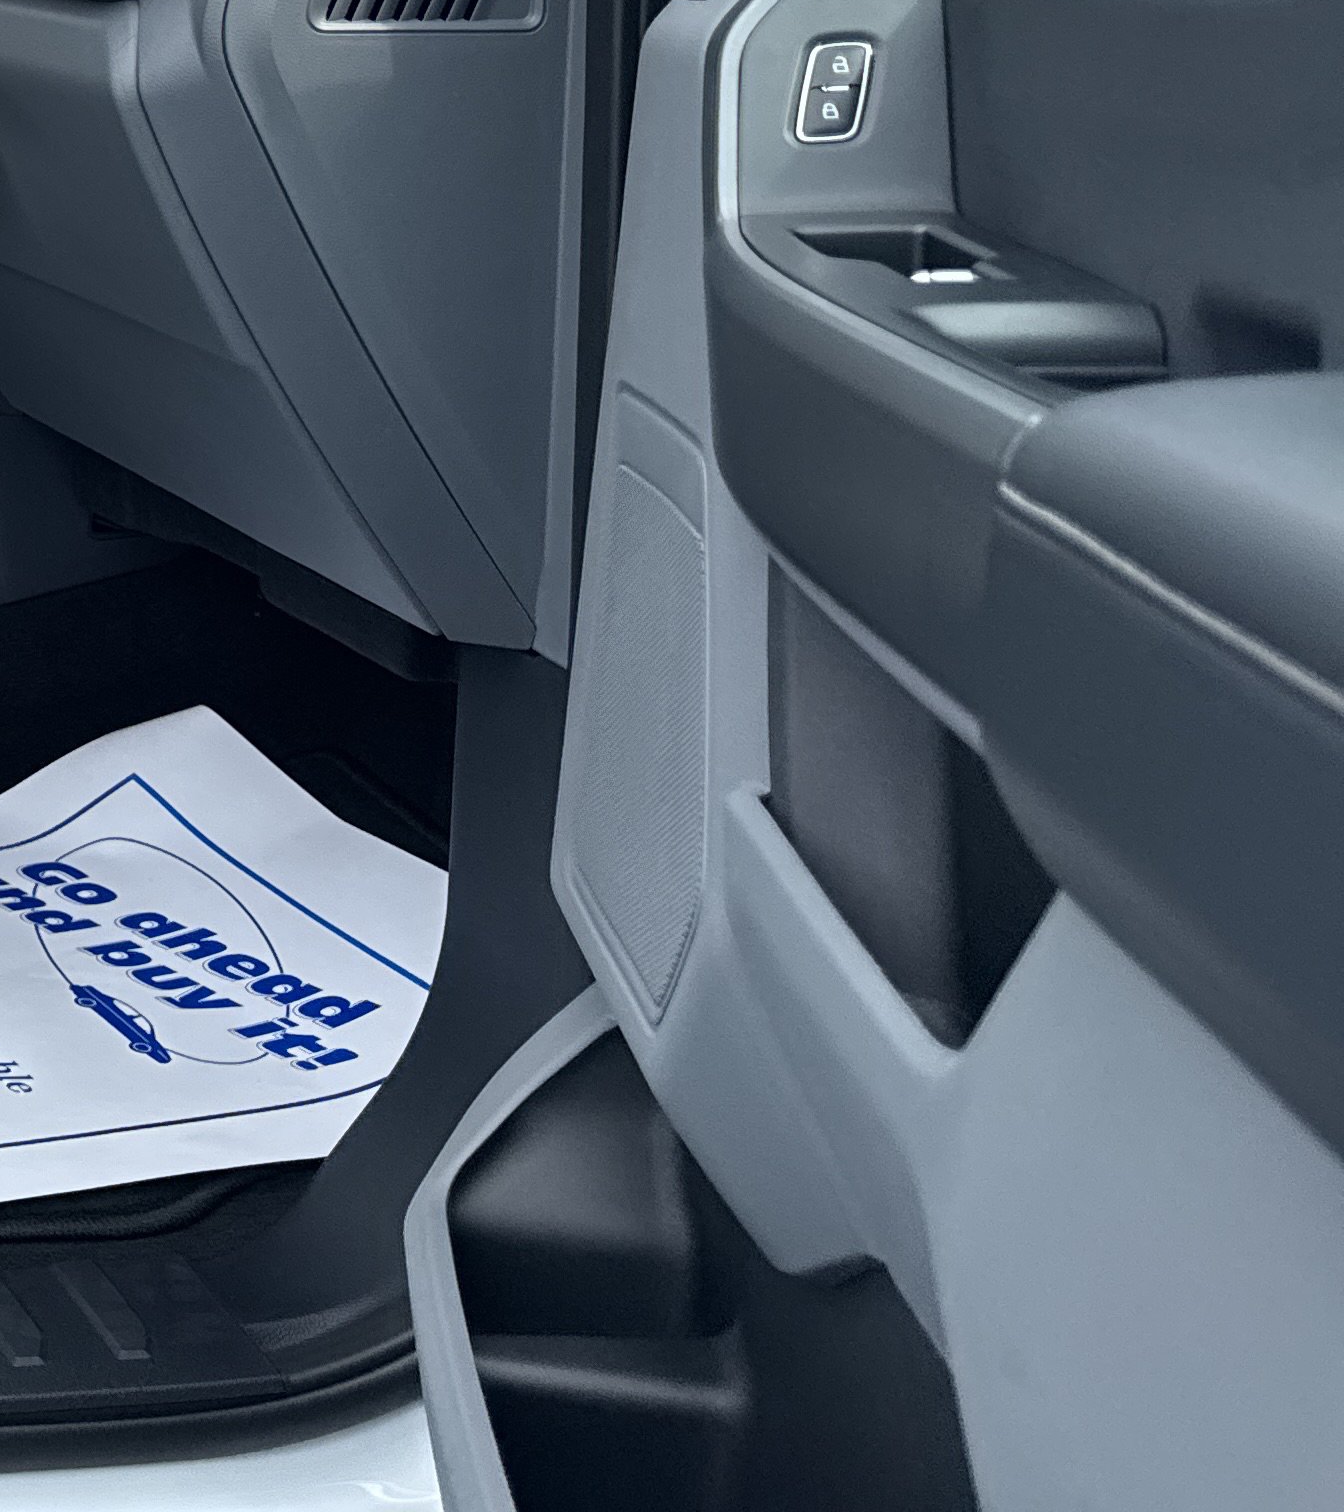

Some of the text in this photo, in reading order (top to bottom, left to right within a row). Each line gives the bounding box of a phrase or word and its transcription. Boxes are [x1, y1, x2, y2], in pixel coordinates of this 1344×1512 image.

[15, 861, 383, 1030] Go ahead
[78, 939, 244, 1010] buy
[227, 1016, 359, 1071] it!
